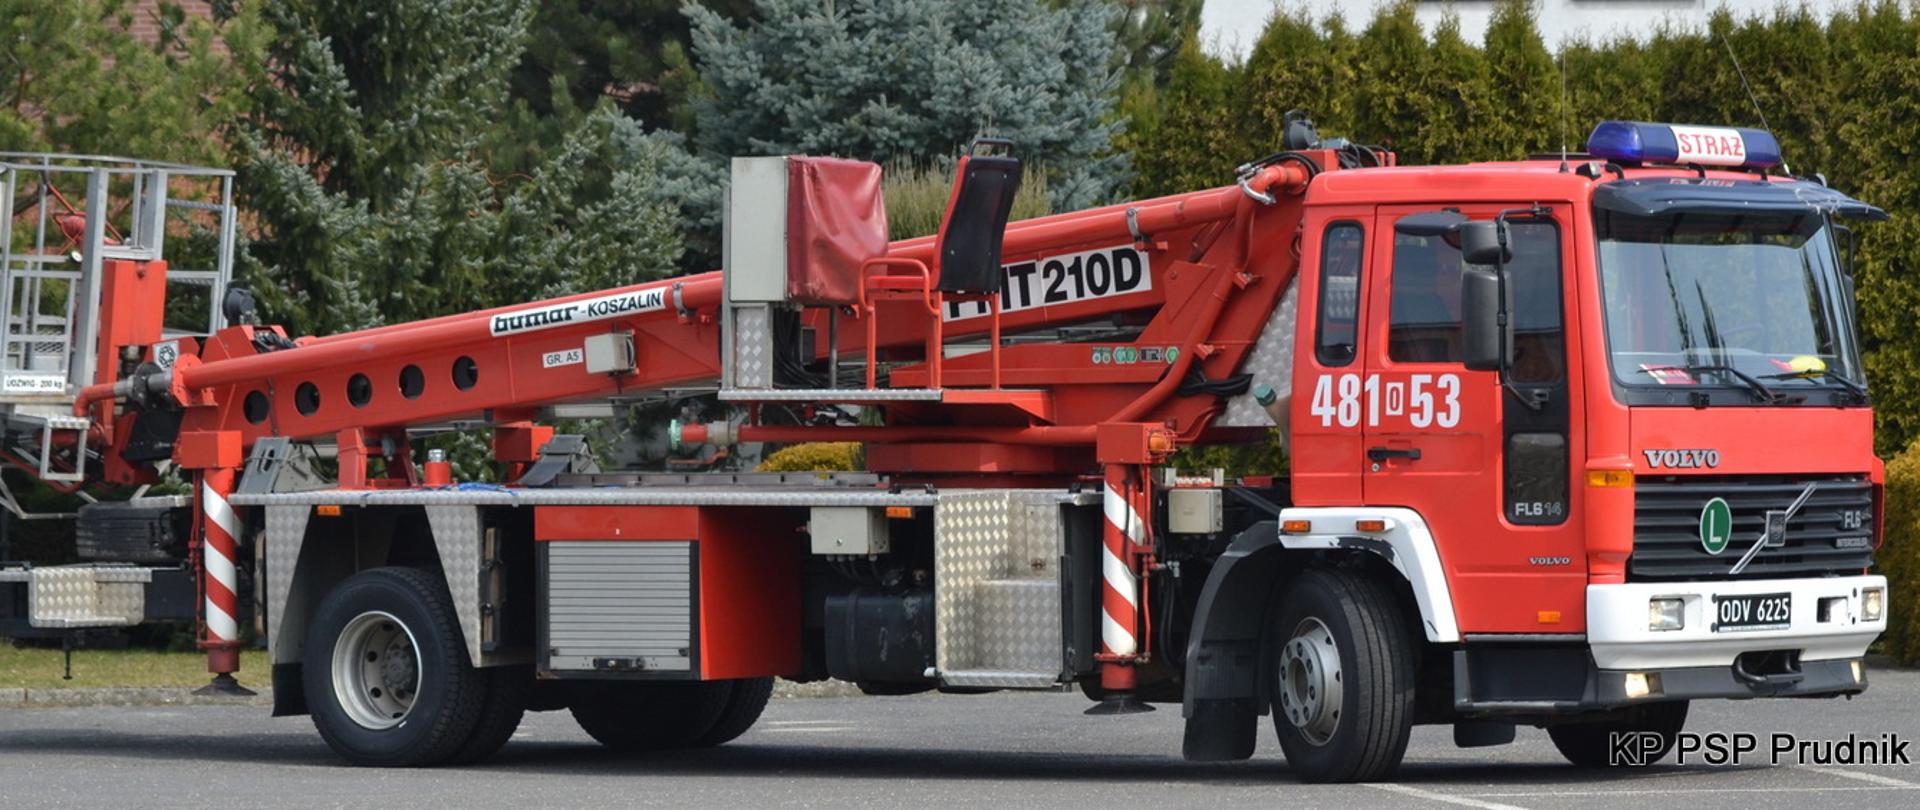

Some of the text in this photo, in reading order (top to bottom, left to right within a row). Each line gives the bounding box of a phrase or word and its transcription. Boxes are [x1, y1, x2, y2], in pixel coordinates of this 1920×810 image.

[1042, 248, 1142, 303] 210D
[566, 351, 580, 362] A5
[1311, 373, 1381, 427] 481
[1409, 373, 1461, 428] 53
[1643, 448, 1720, 469] VOLVO
[1709, 509, 1722, 543] L
[1529, 556, 1571, 566] VOLVO
[1721, 597, 1790, 623] ODV 6225
